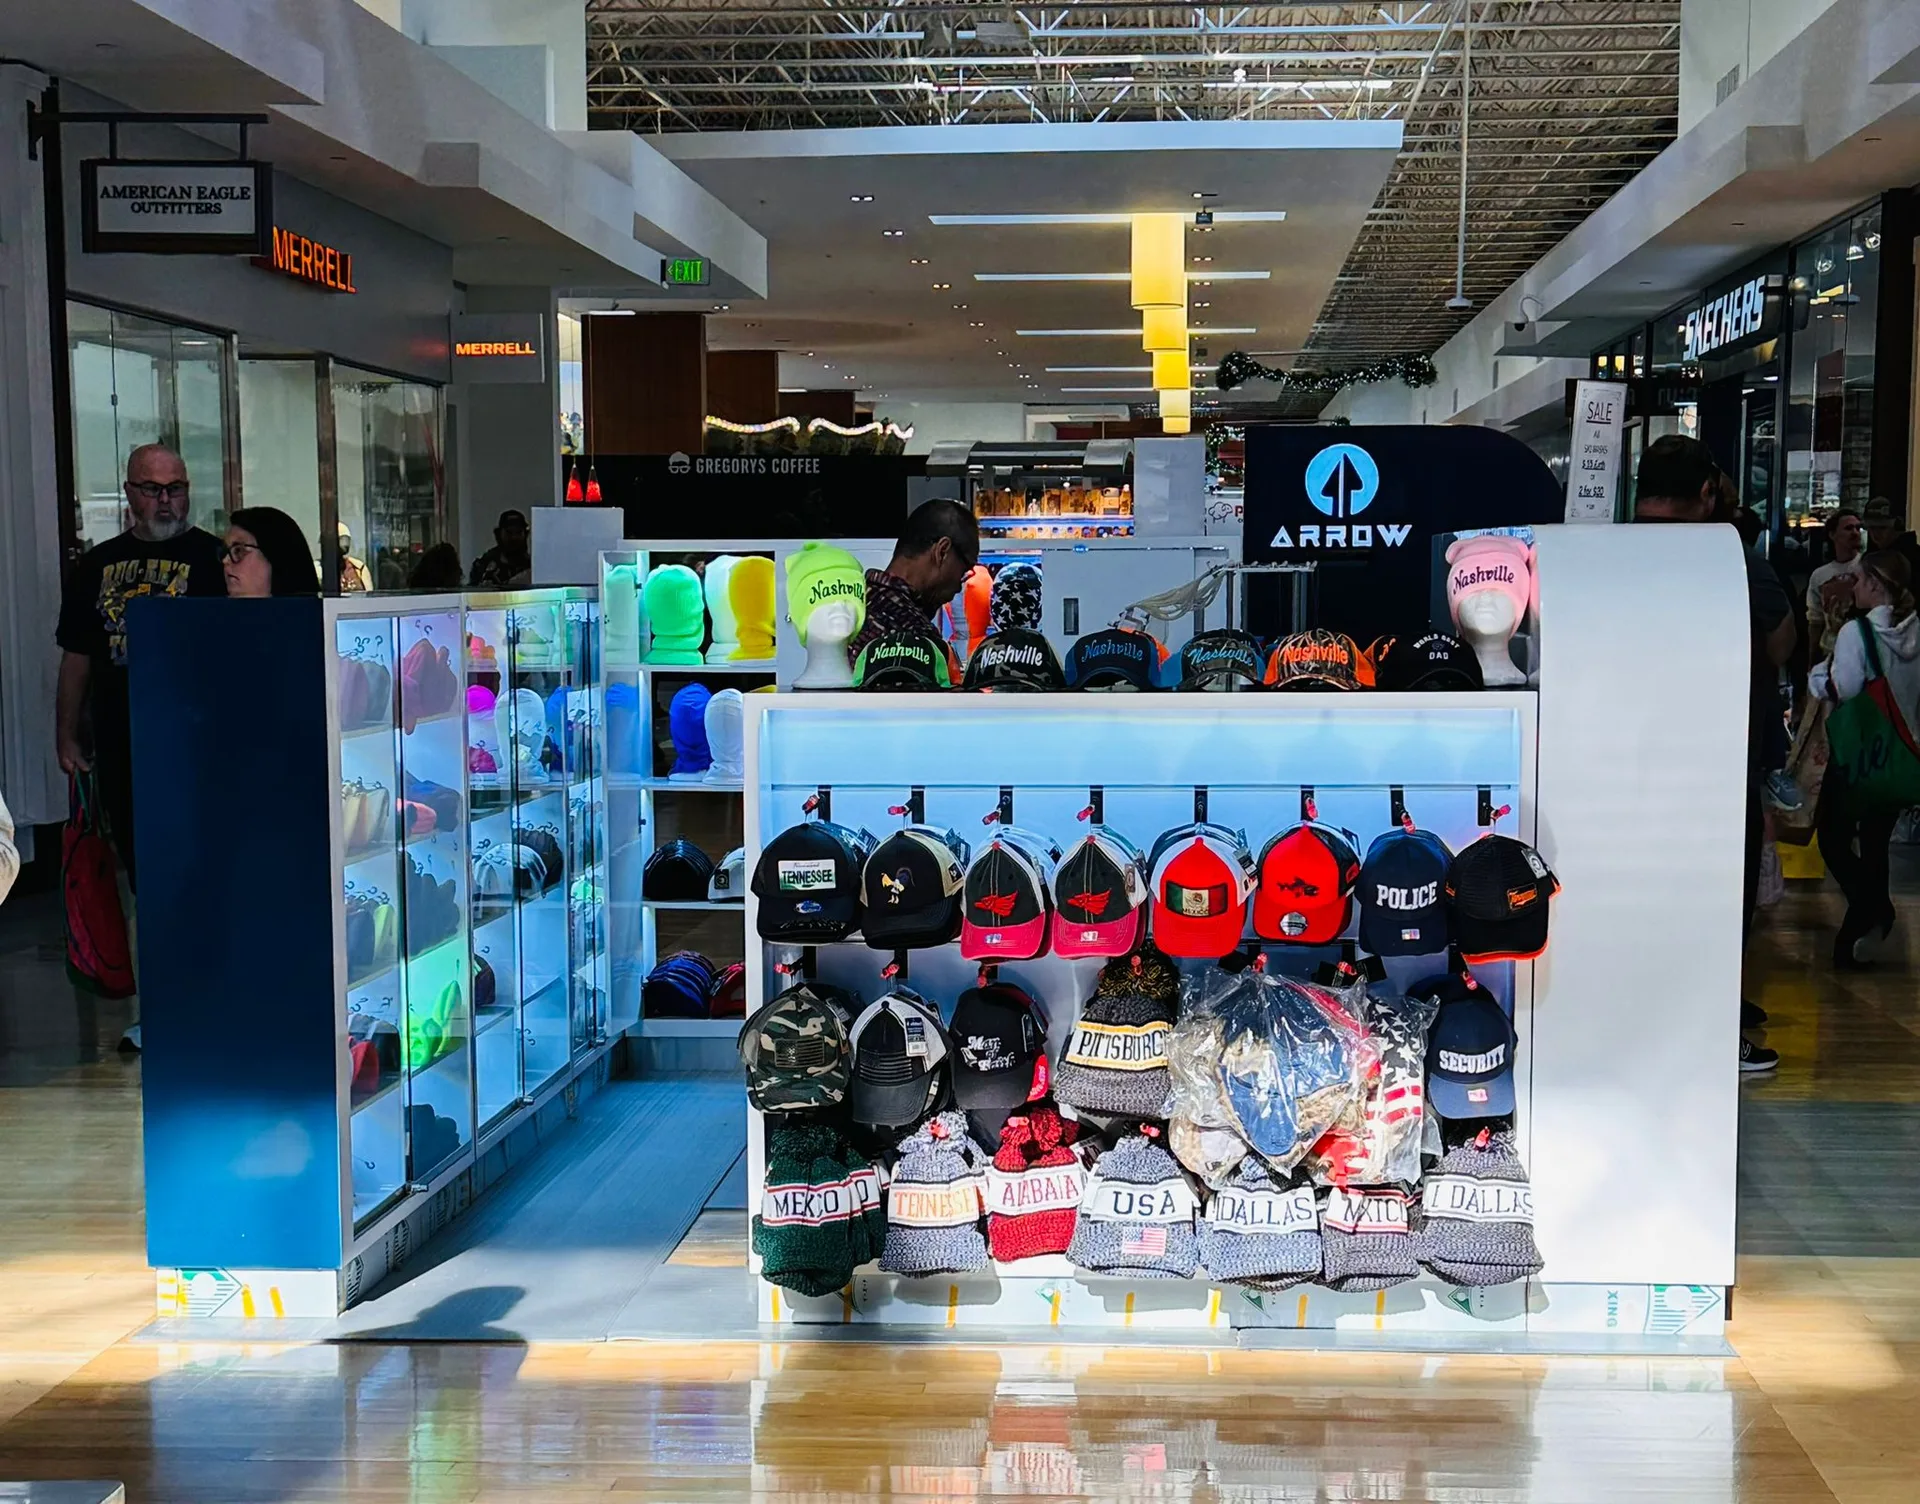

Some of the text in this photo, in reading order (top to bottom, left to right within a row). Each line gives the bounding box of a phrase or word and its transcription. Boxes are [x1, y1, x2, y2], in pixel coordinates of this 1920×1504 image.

[101, 185, 251, 200] AMERICAN EAGLE
[130, 202, 223, 215] OUTFITTERS
[273, 225, 357, 294] MERRELL
[674, 259, 703, 283] EXIT
[1682, 274, 1766, 362] SKECHERS
[456, 342, 536, 355] MERRELL
[1587, 401, 1613, 421] SALE
[695, 458, 821, 474] GREGORYS COFFEE
[1270, 524, 1413, 548] ARROW
[1452, 565, 1515, 595] Nashville
[870, 642, 930, 664] Nashville
[980, 644, 1043, 669] Nashville
[1081, 639, 1144, 663] Nashville
[1188, 645, 1254, 666] Nashville
[1283, 643, 1349, 665] Nashville
[1428, 652, 1449, 660] DAD
[781, 868, 834, 885] TENNESSEE
[1376, 881, 1438, 910] POLICE
[1076, 1029, 1170, 1061] PITTSBURG
[1439, 1043, 1506, 1074] SECURITY
[1002, 1174, 1079, 1207] ALABAA
[1451, 1185, 1533, 1216] DALLAS
[1112, 1189, 1176, 1217] USA
[1220, 1196, 1313, 1226] DALLAS
